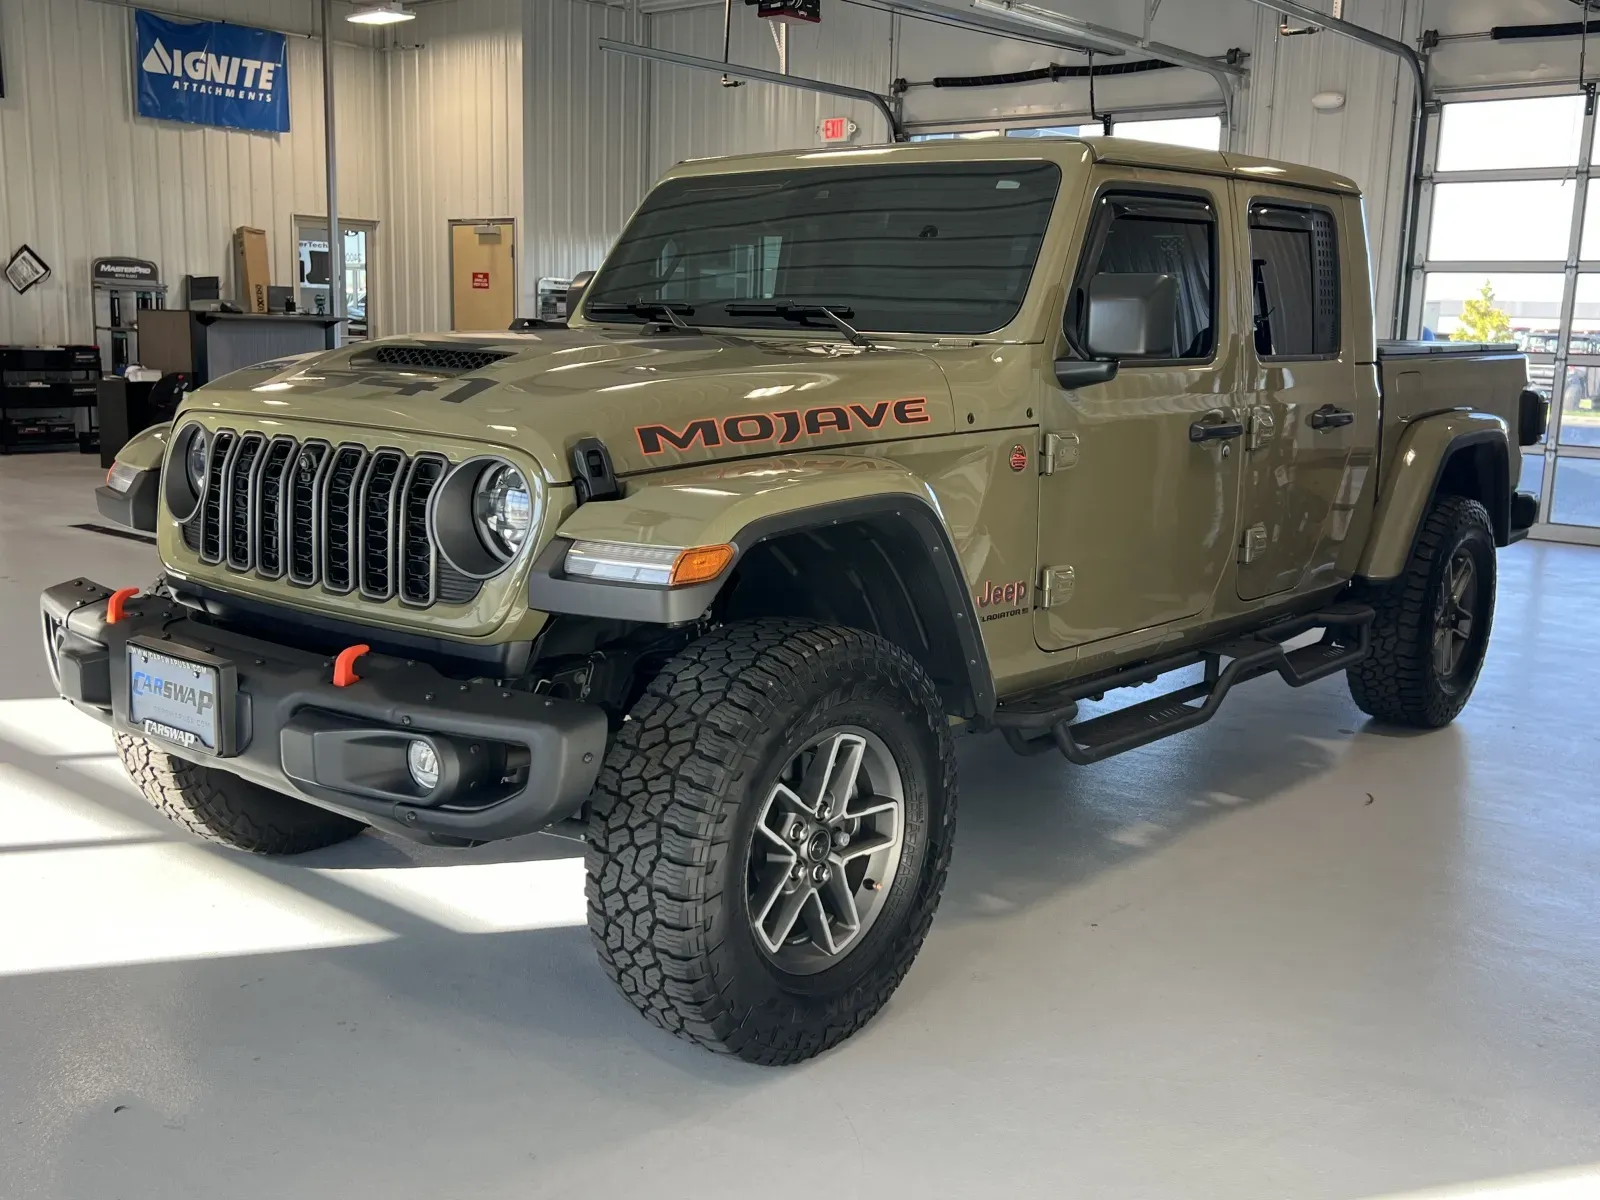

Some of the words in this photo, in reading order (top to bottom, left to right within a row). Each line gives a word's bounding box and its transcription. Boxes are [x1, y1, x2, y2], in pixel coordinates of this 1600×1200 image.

[172, 49, 275, 91] IGNITE
[172, 80, 273, 103] ATTACHMENTS
[825, 119, 844, 139] EXIT
[633, 397, 931, 457] MOJAVE
[976, 580, 1026, 608] Jeep
[980, 609, 1020, 622] LADIATOR
[132, 671, 214, 715] CARSWAP
[144, 719, 195, 747] CARSWAP
